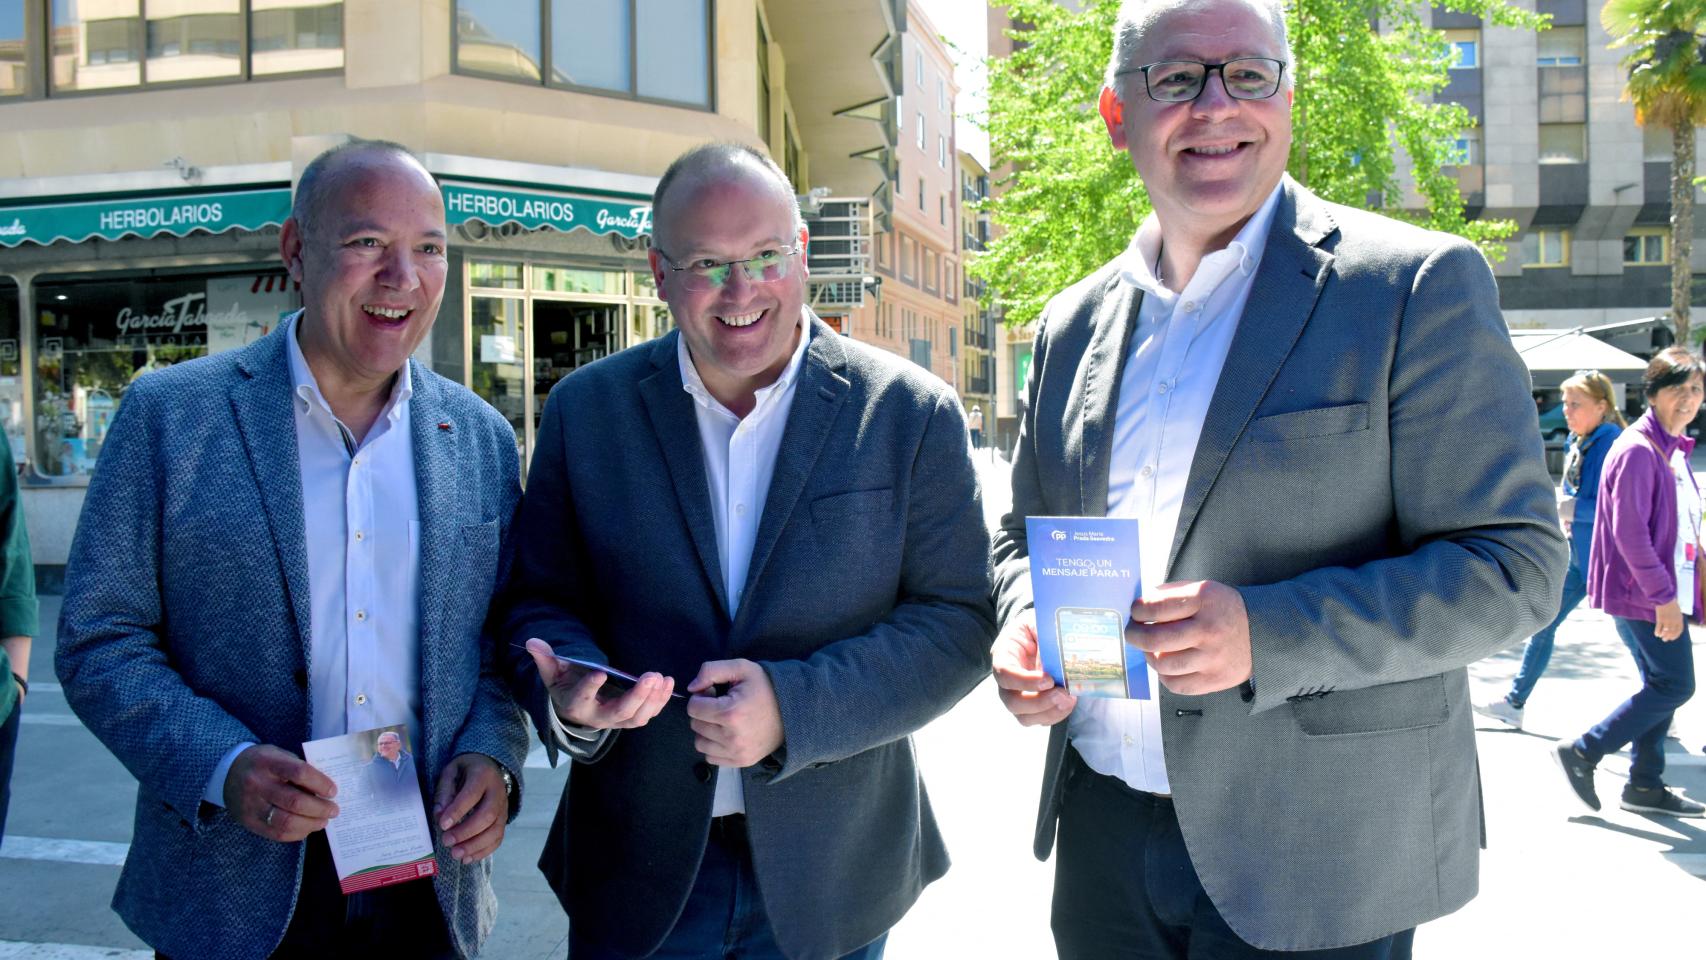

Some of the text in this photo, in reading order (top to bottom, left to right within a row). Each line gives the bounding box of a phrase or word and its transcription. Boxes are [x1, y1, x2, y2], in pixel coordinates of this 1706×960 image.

[448, 191, 574, 222] HERBOLARIOS
[100, 203, 223, 230] HERBOLARIOS
[1042, 567, 1131, 578] MENSAJE PARA TI
[1055, 558, 1112, 568] TENGO UN
